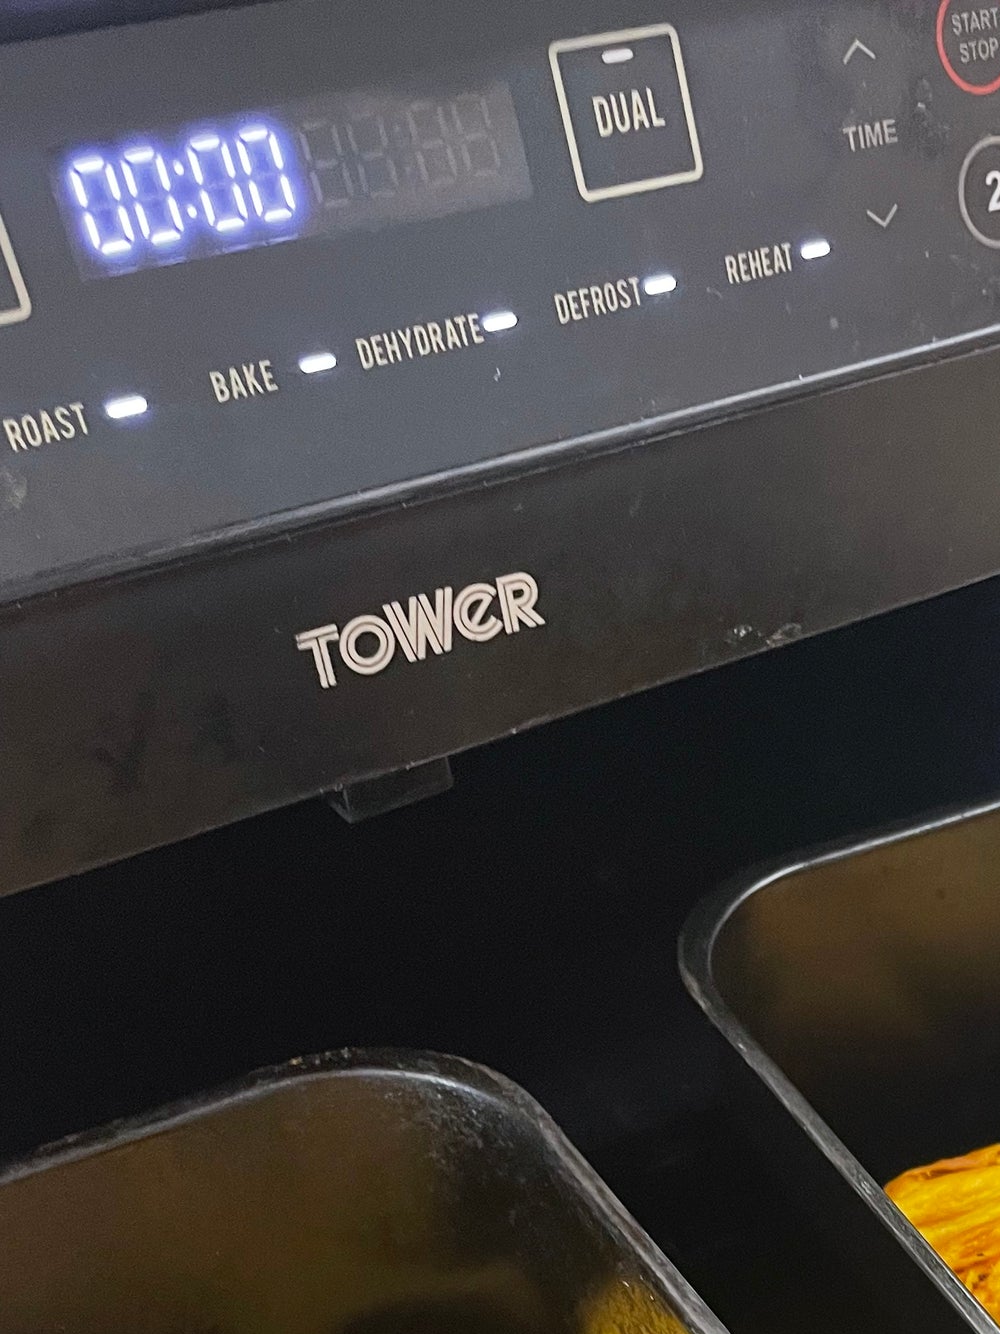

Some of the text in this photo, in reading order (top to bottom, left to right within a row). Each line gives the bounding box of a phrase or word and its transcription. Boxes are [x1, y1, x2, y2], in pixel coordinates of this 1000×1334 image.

[951, 7, 998, 36] START
[959, 37, 999, 64] STOP
[591, 86, 666, 138] DUAL
[843, 118, 899, 152] TIME
[69, 126, 297, 254] 00:00
[725, 242, 793, 285] REHEAT
[554, 276, 642, 325] DEFROST
[355, 312, 485, 371] DEHYDRATE
[209, 359, 279, 404] BAKE
[2, 401, 89, 453] ROAST
[295, 571, 546, 689] TOWER
